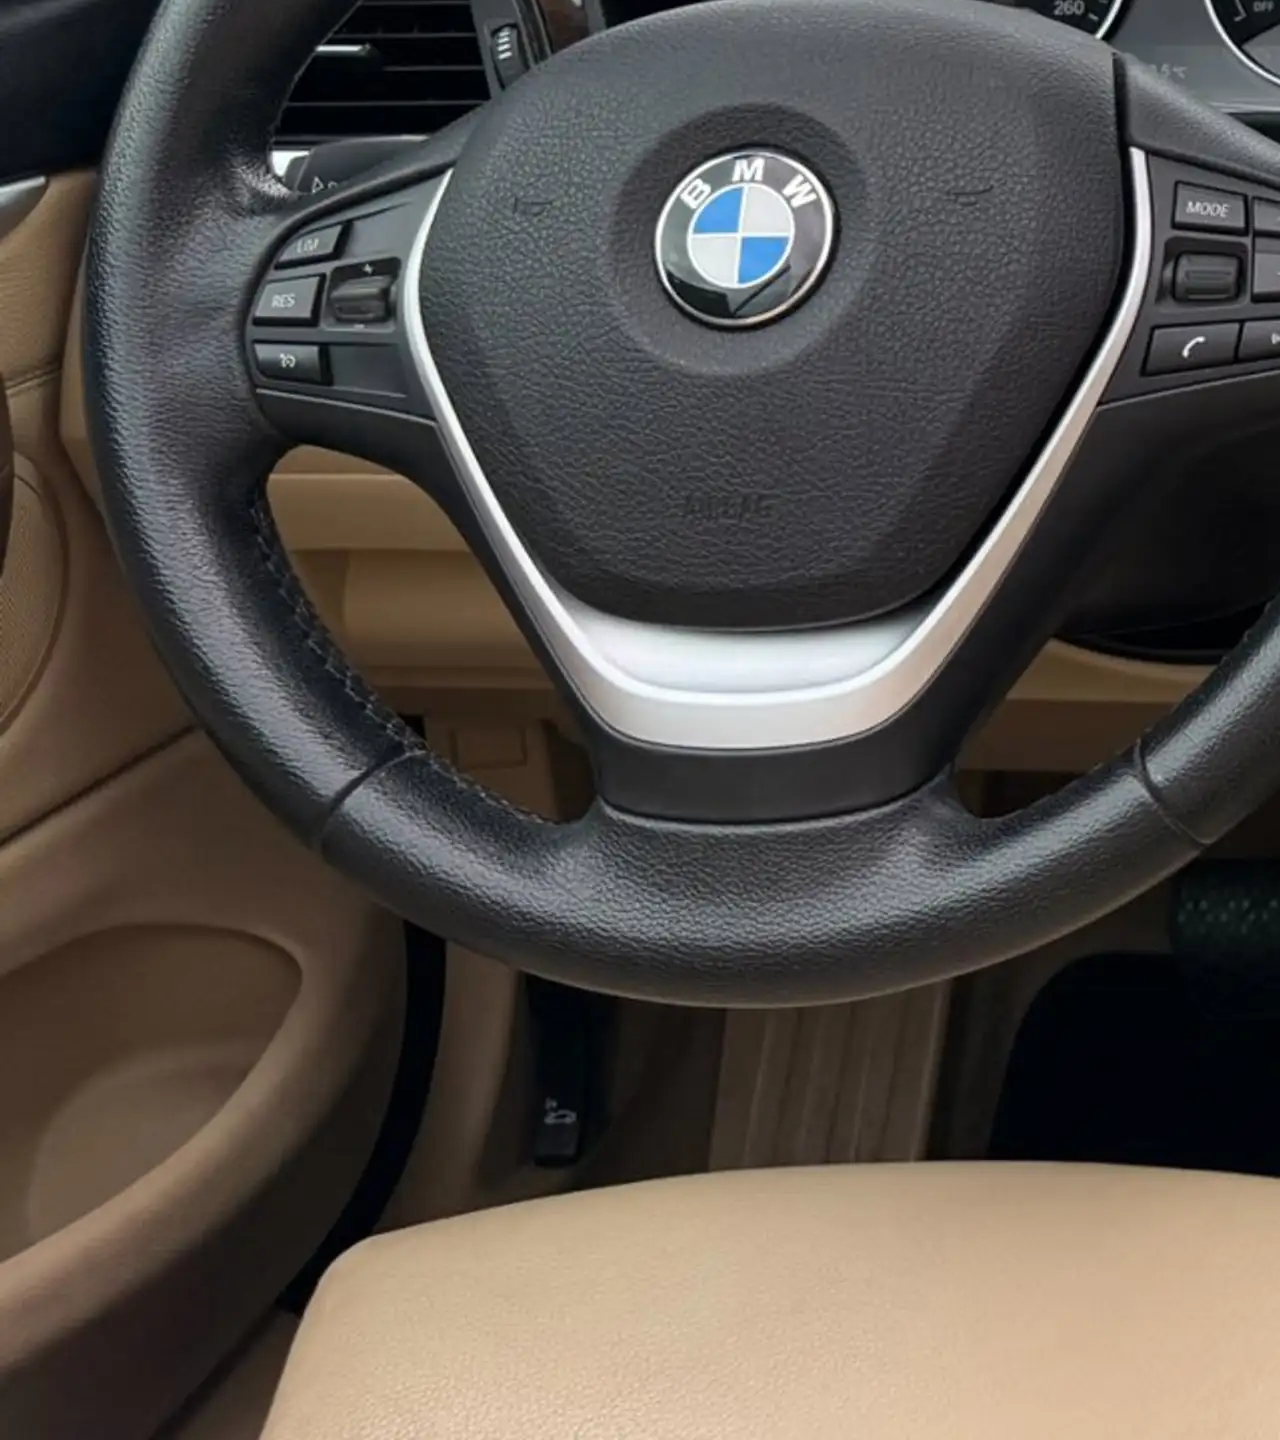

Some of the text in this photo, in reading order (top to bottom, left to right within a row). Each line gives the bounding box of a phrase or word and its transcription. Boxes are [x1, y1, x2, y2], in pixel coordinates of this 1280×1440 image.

[1054, 0, 1085, 15] 260
[1253, 1, 1274, 11] OFF
[680, 158, 817, 209] BMW
[1186, 201, 1230, 219] MODE
[271, 293, 295, 309] RES
